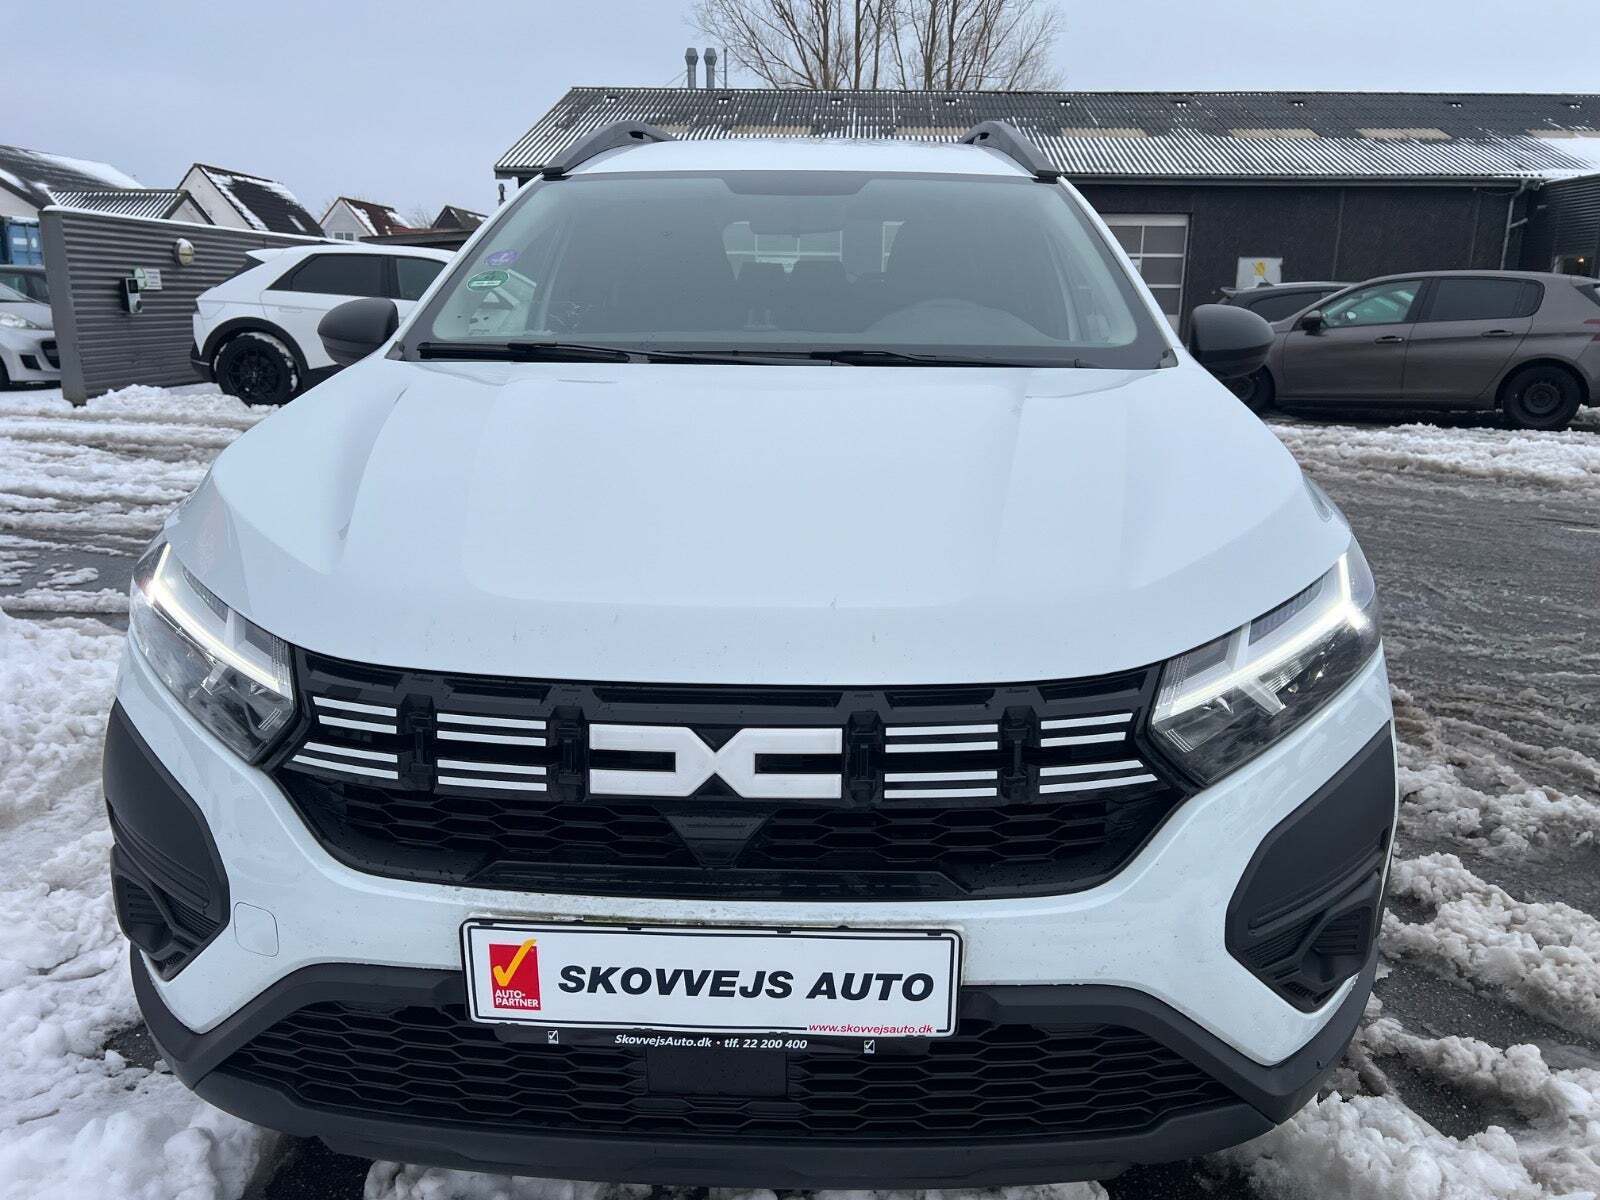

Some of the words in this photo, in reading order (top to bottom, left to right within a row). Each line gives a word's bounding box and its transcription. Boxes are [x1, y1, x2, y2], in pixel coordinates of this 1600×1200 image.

[557, 965, 794, 999] SKOVVEJS
[805, 972, 935, 1001] AUTO
[494, 989, 526, 999] AUTO-
[495, 998, 540, 1008] PARTNER
[808, 1023, 934, 1036] www.skovvejsauto.dk
[614, 1034, 713, 1048] SkovvejsAuto.dk
[742, 1039, 758, 1049] 22
[760, 1039, 784, 1049] 200
[786, 1039, 808, 1050] 400
